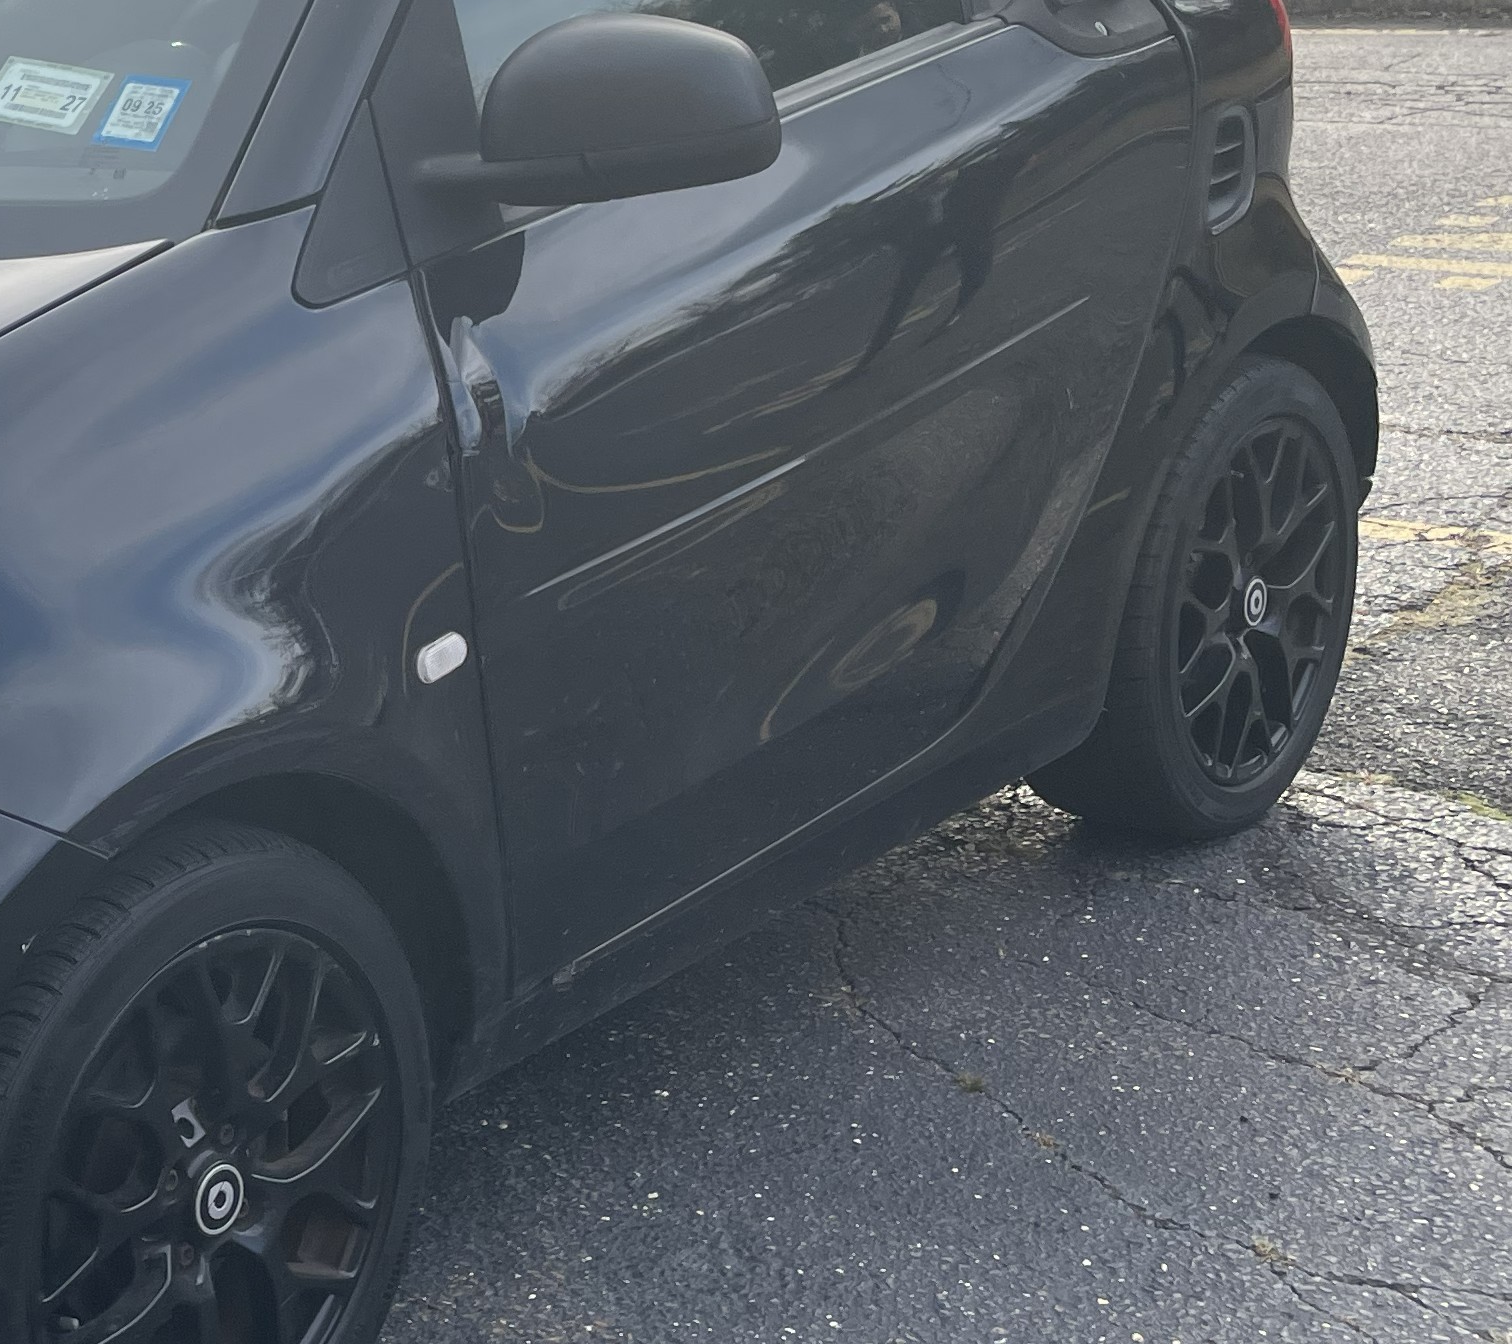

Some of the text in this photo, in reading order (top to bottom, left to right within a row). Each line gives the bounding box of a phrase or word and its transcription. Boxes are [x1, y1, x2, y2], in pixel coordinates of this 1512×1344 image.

[1, 84, 23, 101] 11
[59, 95, 87, 112] 27
[121, 98, 165, 115] 09 25
